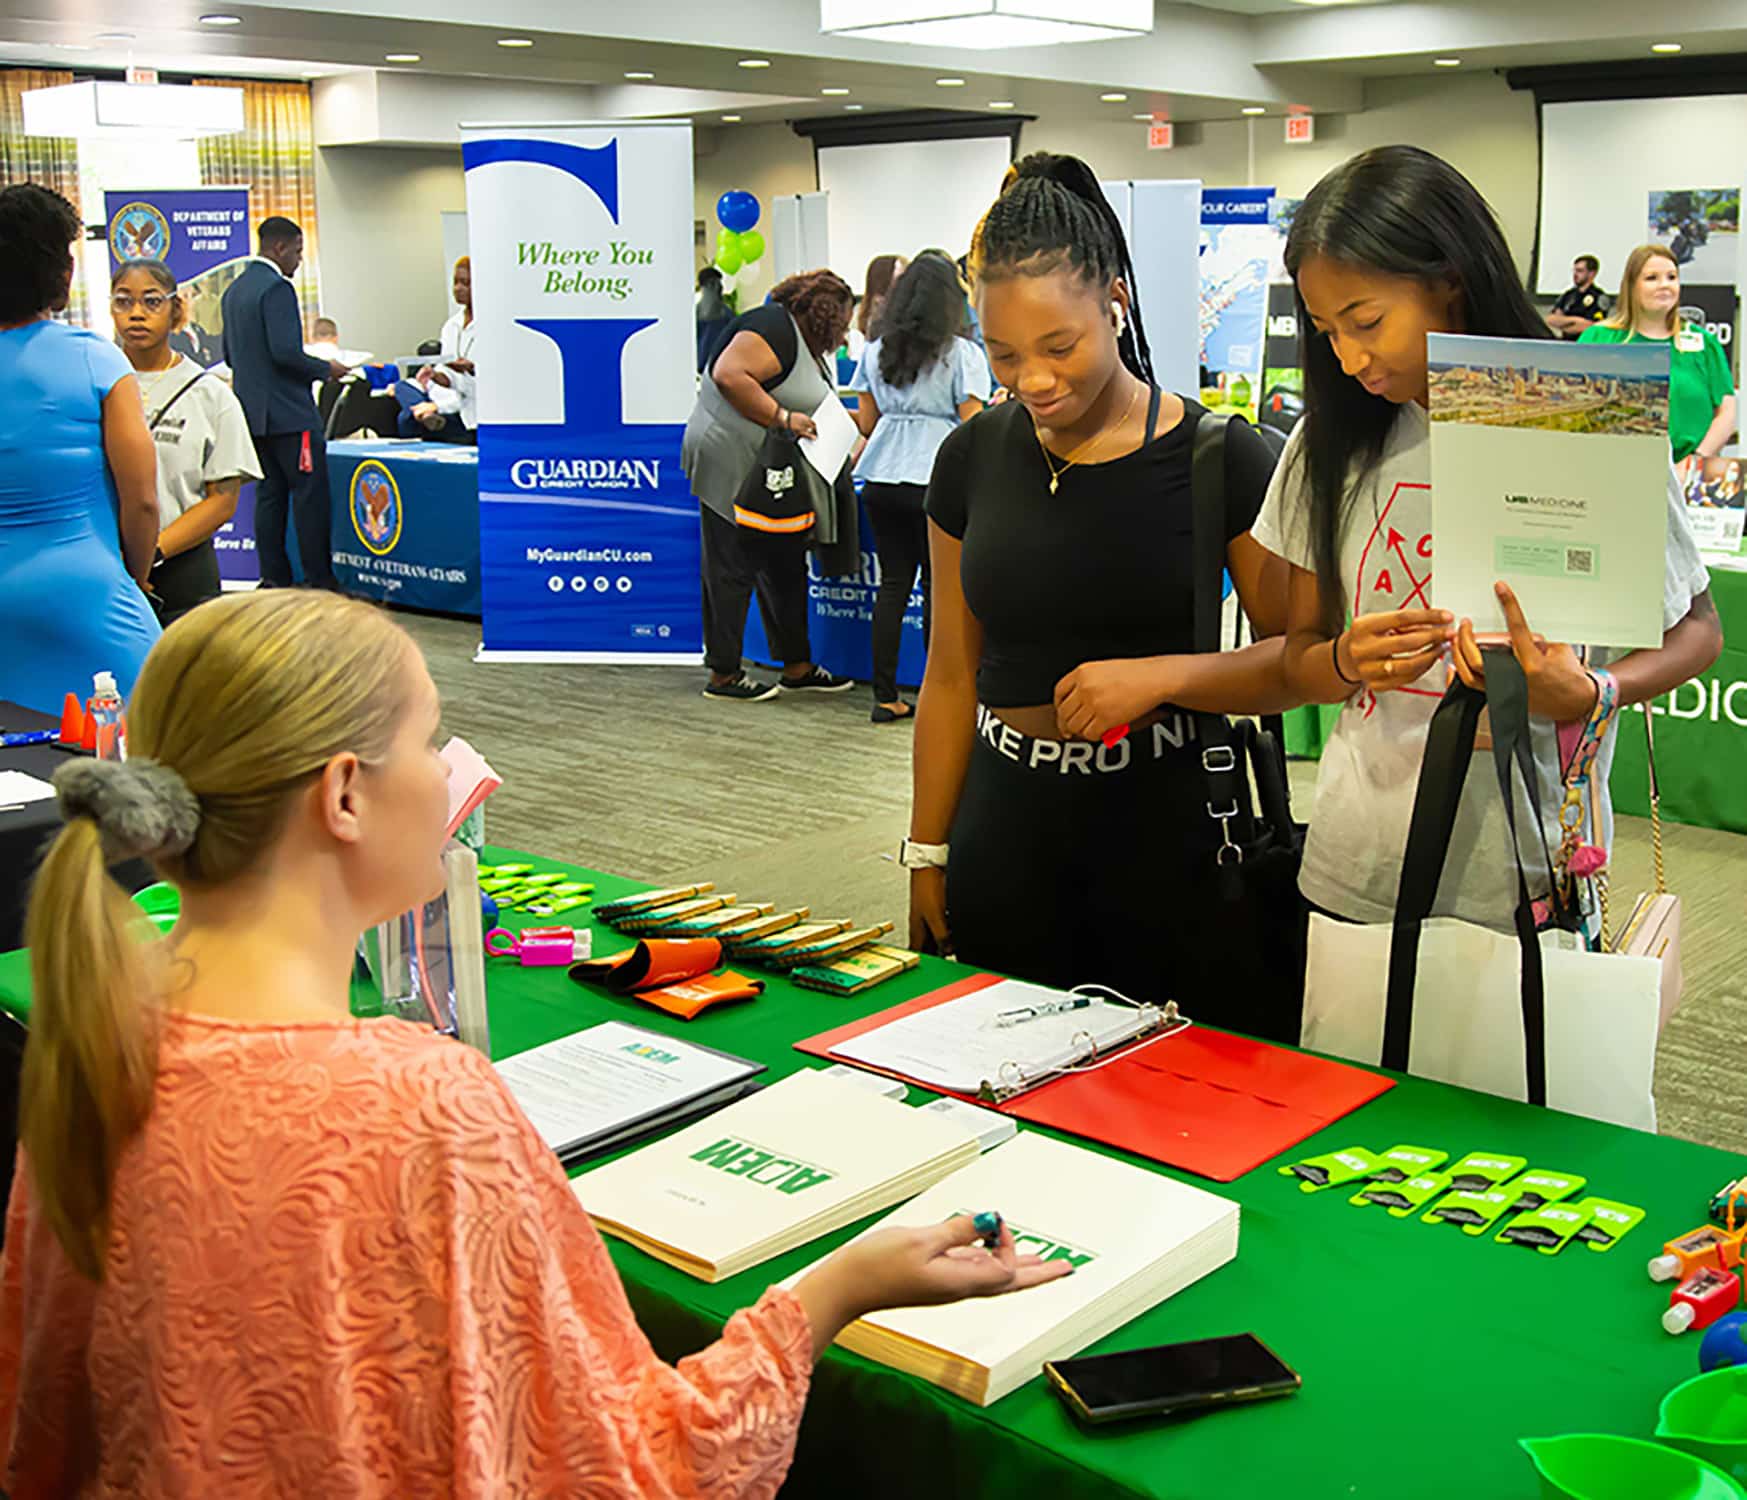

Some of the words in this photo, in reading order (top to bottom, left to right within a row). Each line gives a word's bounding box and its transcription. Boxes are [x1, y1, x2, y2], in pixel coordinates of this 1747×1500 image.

[1150, 127, 1169, 147] EXIT
[1289, 119, 1309, 139] EXIT
[172, 211, 231, 223] DEPARTMENT
[232, 210, 246, 222] OF
[186, 225, 232, 237] VETERANS
[191, 239, 228, 251] AFFAIRS
[516, 242, 600, 266] Where
[608, 242, 655, 265] You
[543, 271, 634, 300] Belong.
[511, 459, 661, 489] GUARDIAN
[539, 480, 584, 488] CREDIT
[587, 480, 629, 488] UNION
[526, 547, 654, 564] MyGuardianCU.com
[1373, 568, 1393, 594] A
[808, 584, 868, 602] CREDIT
[1028, 737, 1131, 775] PRO
[687, 1138, 833, 1195] ADEM
